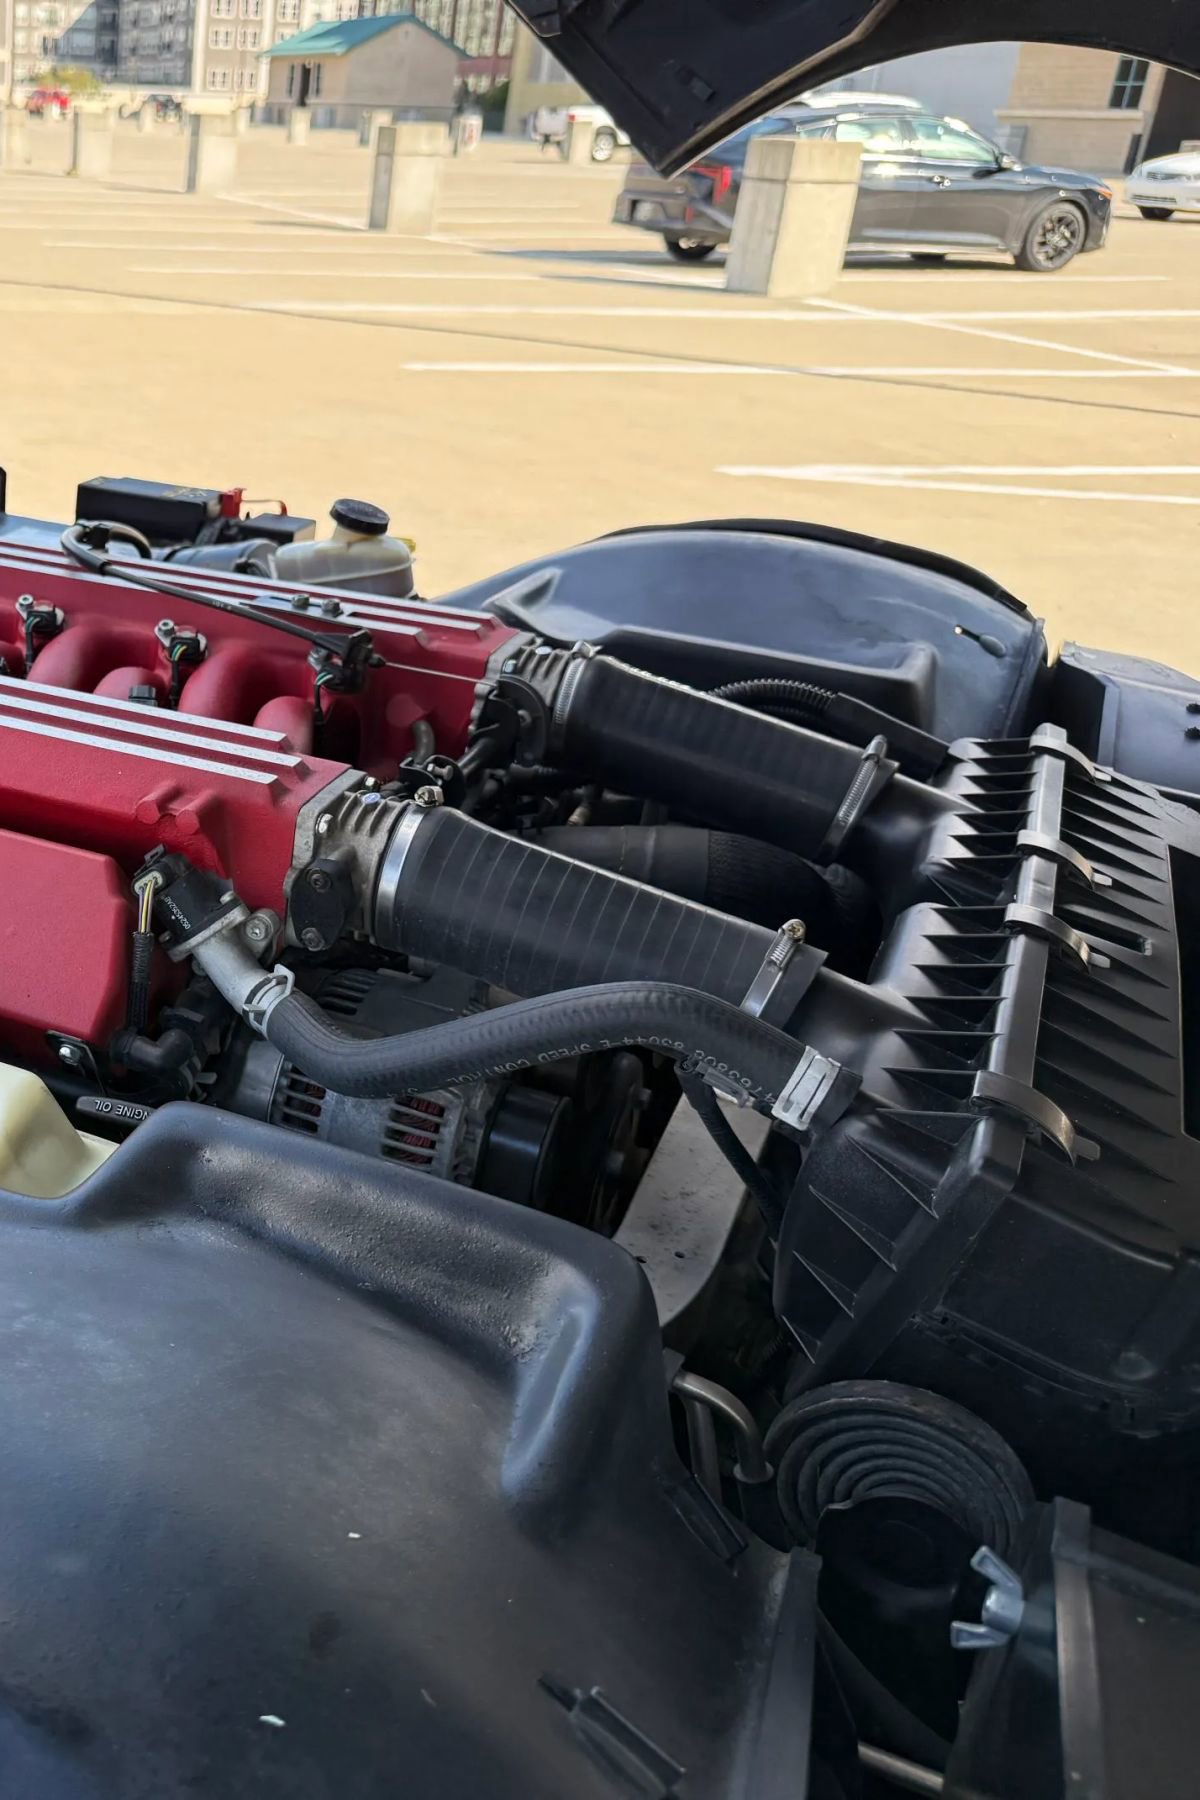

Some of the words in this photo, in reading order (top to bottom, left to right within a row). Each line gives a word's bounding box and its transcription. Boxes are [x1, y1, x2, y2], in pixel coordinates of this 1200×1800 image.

[538, 1043, 591, 1062] SPEED
[94, 1099, 112, 1112] OIL
[115, 1104, 148, 1120] NGINE
